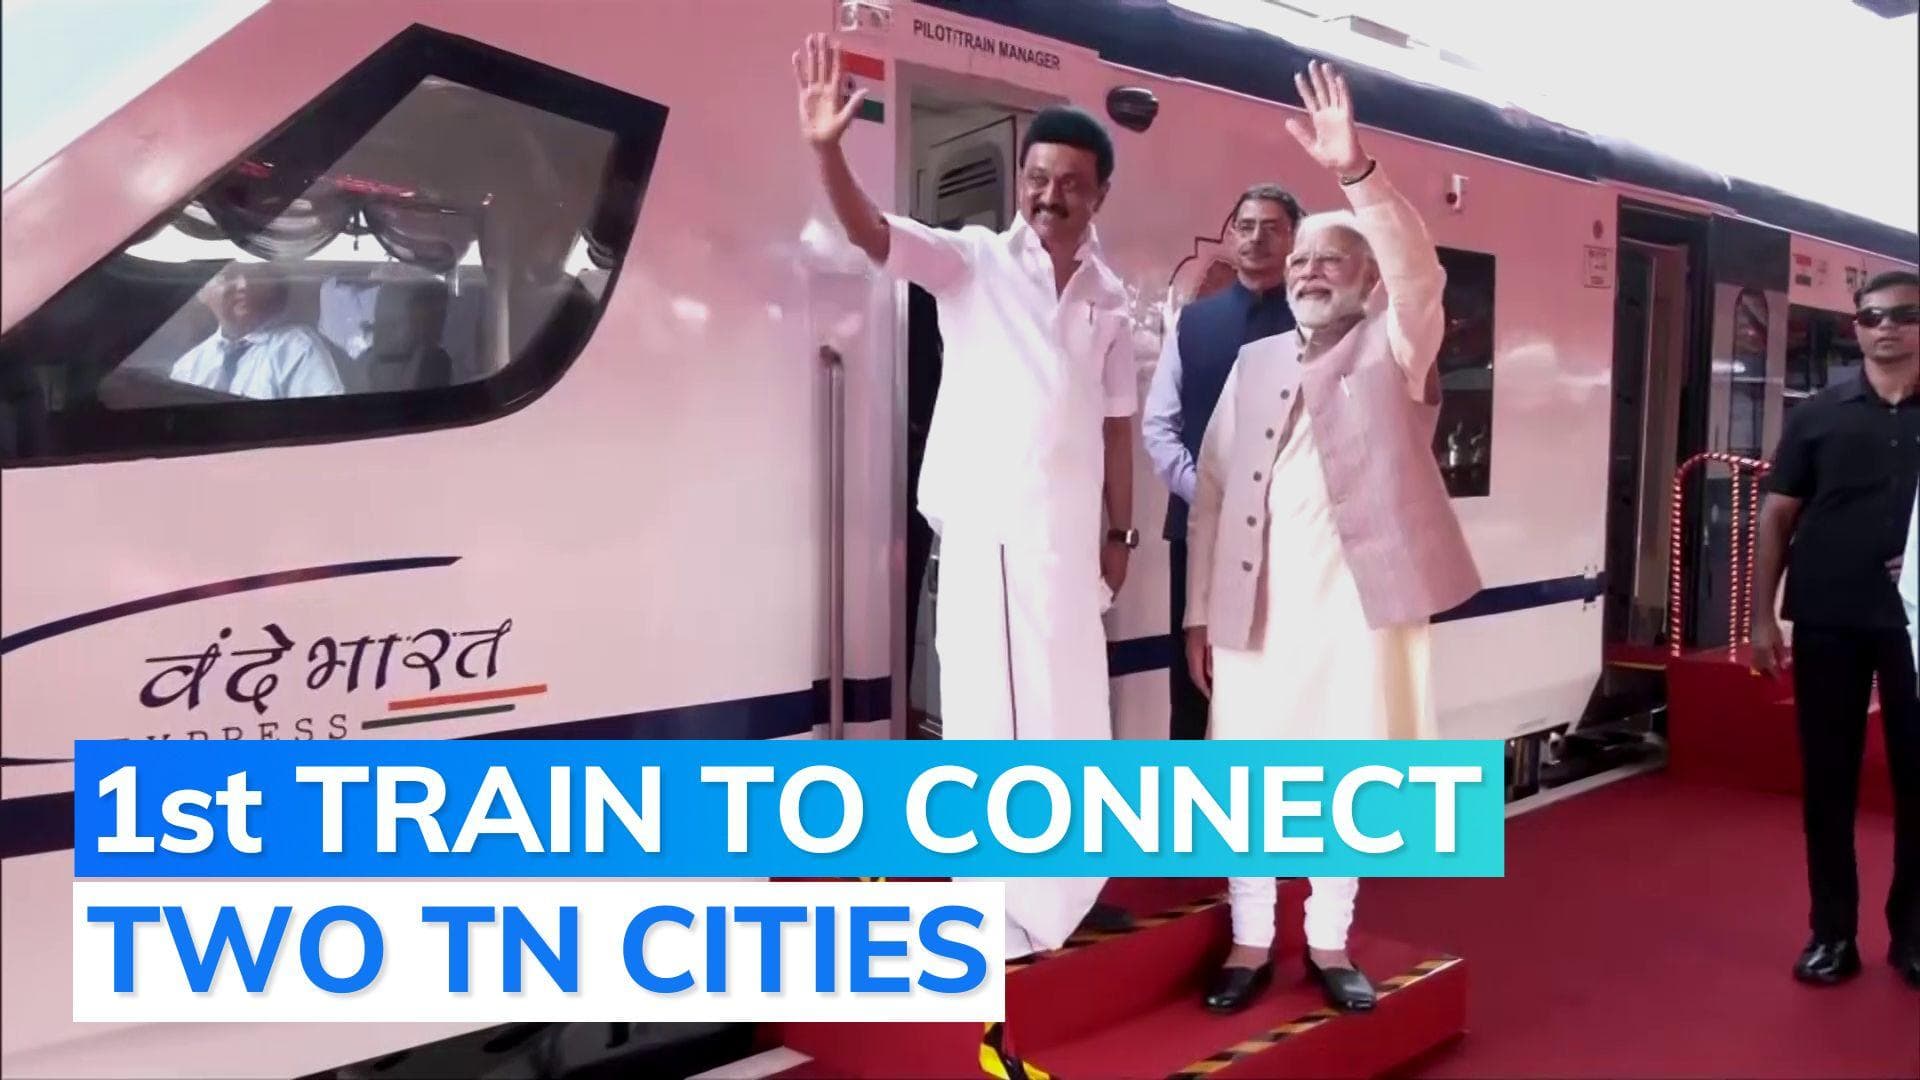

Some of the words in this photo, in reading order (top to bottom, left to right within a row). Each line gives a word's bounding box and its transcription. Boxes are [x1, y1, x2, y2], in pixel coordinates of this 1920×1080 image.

[913, 19, 996, 54] PILOT/TRAIN
[999, 40, 1060, 70] MANAGER
[139, 623, 294, 714] वंदे
[306, 617, 513, 691] भारत
